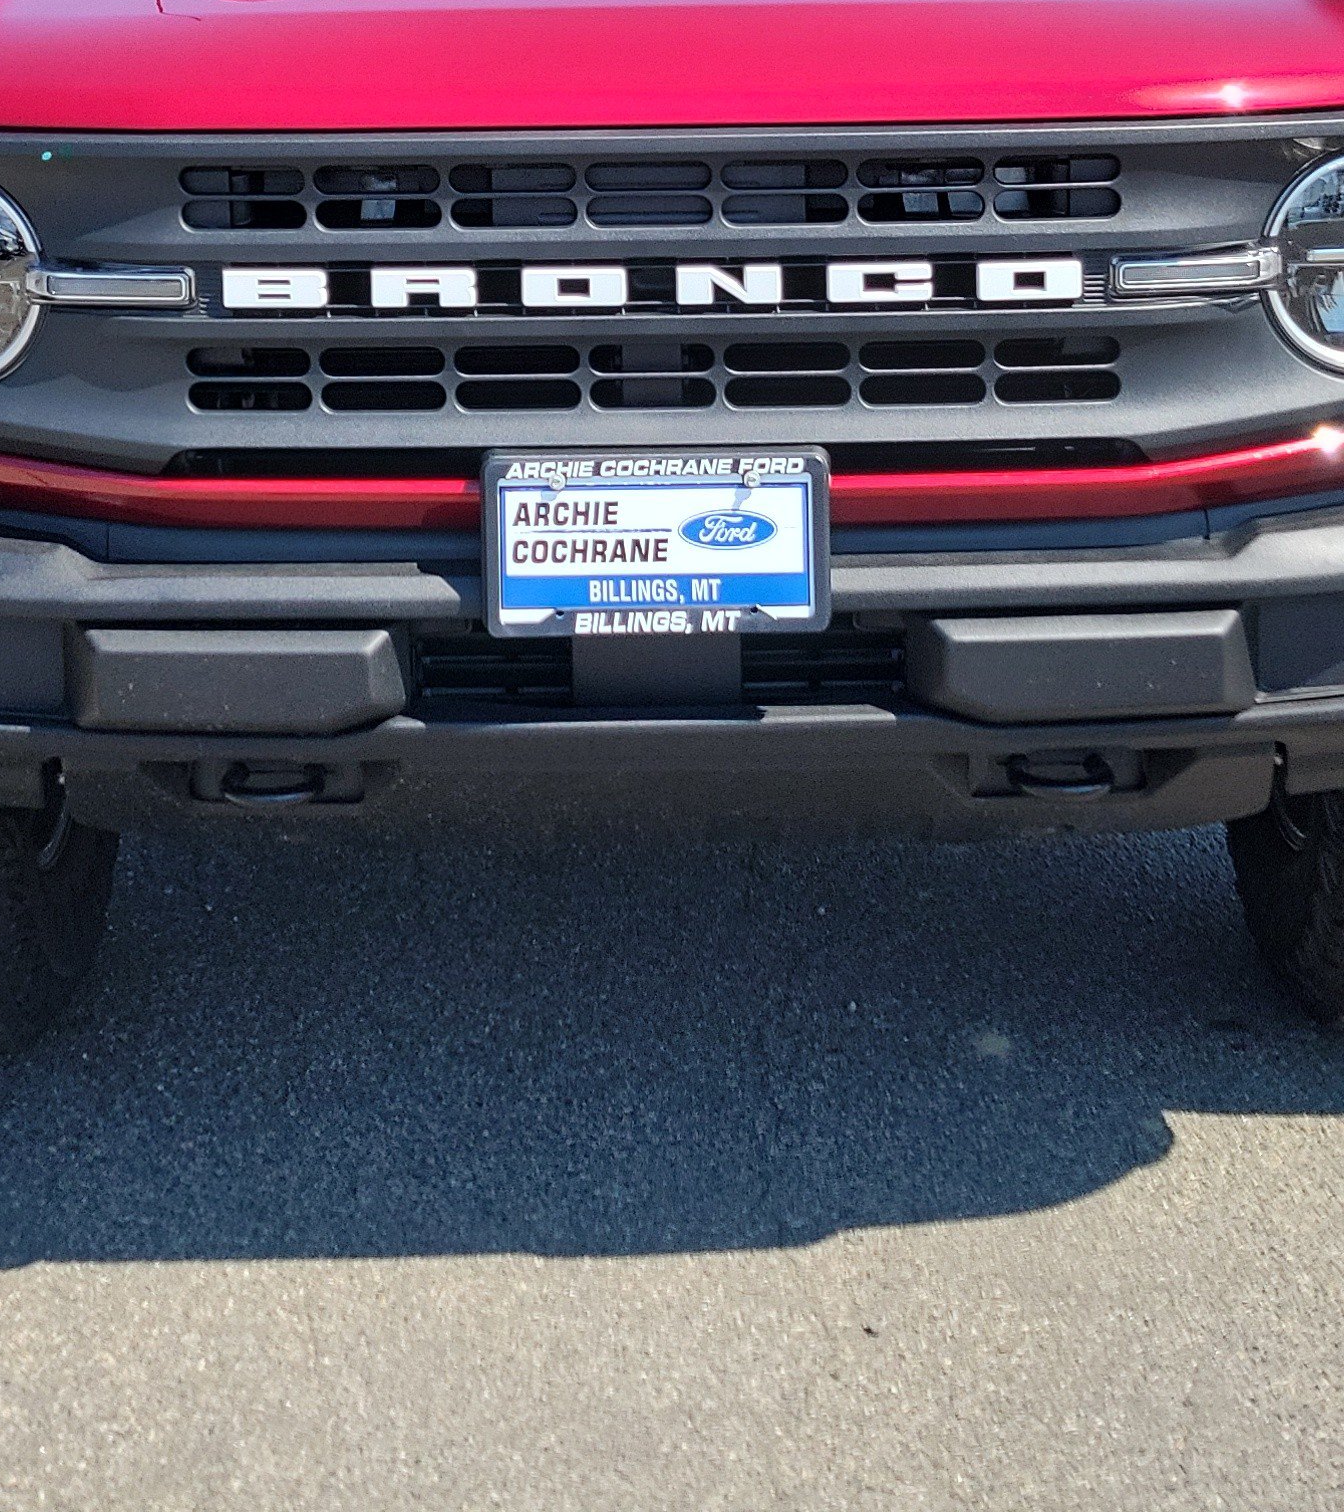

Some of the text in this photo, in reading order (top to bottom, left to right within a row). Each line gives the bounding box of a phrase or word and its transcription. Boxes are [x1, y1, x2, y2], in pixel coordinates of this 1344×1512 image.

[222, 259, 1083, 308] BRONCO
[506, 457, 804, 480] ARCHIE COCHRANE FORD
[512, 500, 620, 528] ARCHIE
[698, 514, 757, 544] Ford
[512, 537, 669, 565] COCHRANE
[588, 578, 722, 605] BILLINGS, MT
[574, 610, 741, 635] BILLINGS, MT
